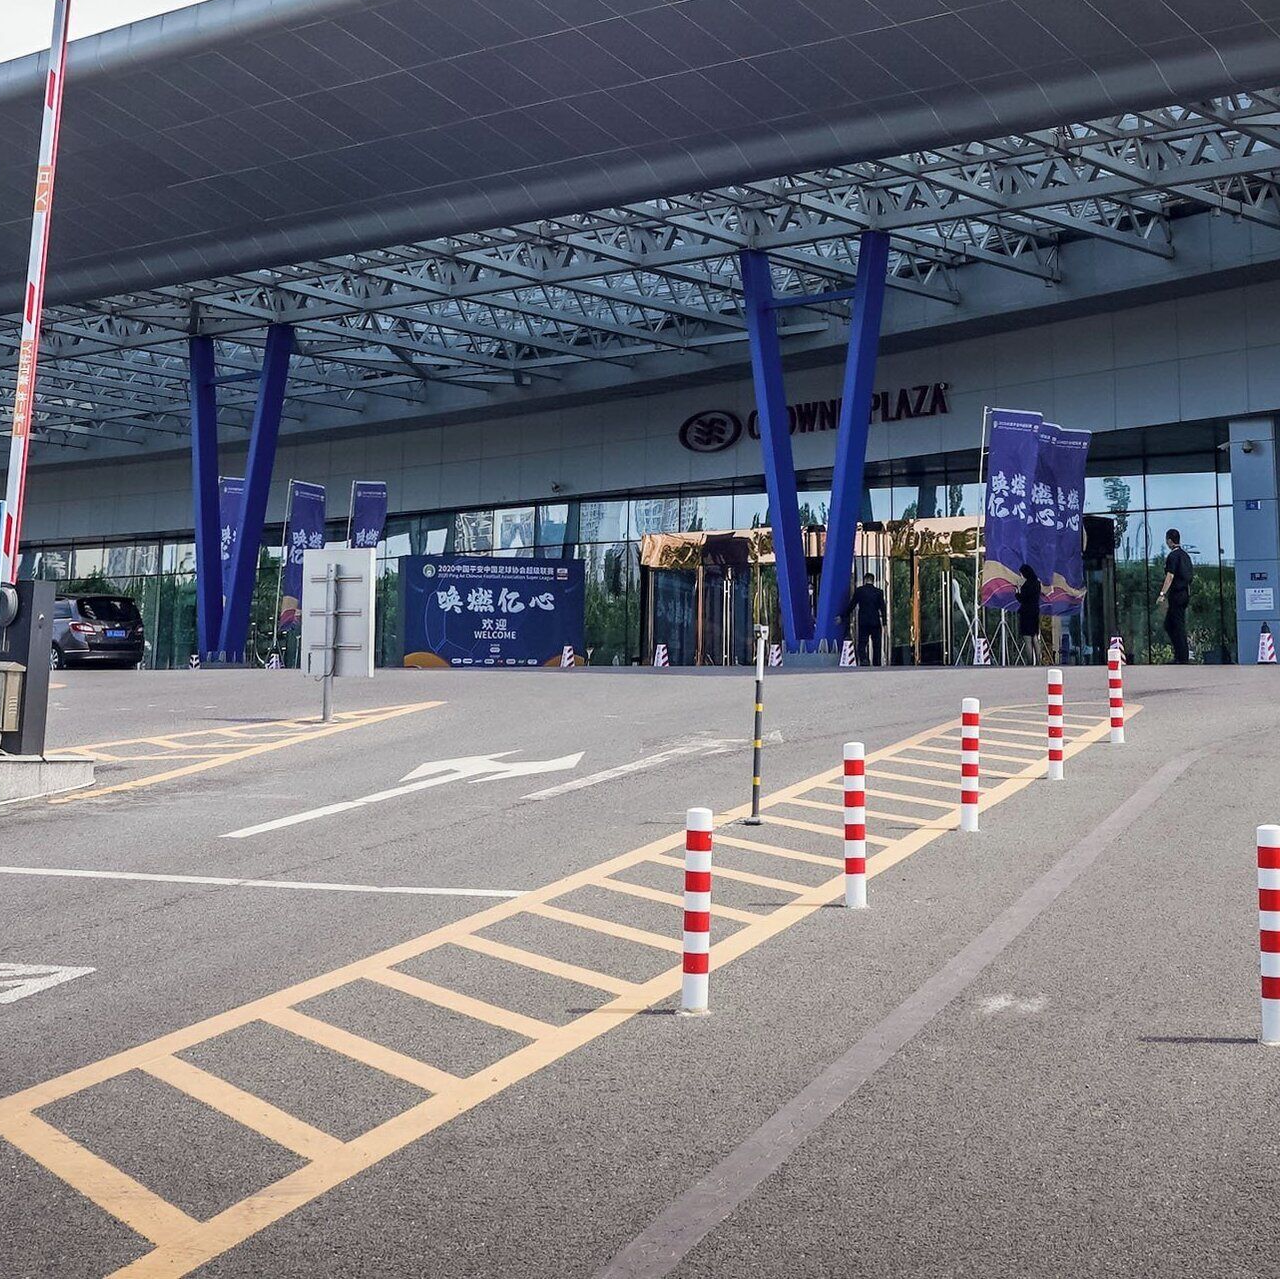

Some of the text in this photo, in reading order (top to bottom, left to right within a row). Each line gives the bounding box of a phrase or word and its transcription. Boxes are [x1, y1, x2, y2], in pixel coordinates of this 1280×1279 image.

[36, 171, 49, 206] 入口
[868, 383, 948, 425] PLAZA
[438, 564, 555, 576] 2020中国平安中国足球协会超级联赛
[481, 618, 507, 631] 欢迎
[473, 631, 517, 640] WELCOME
